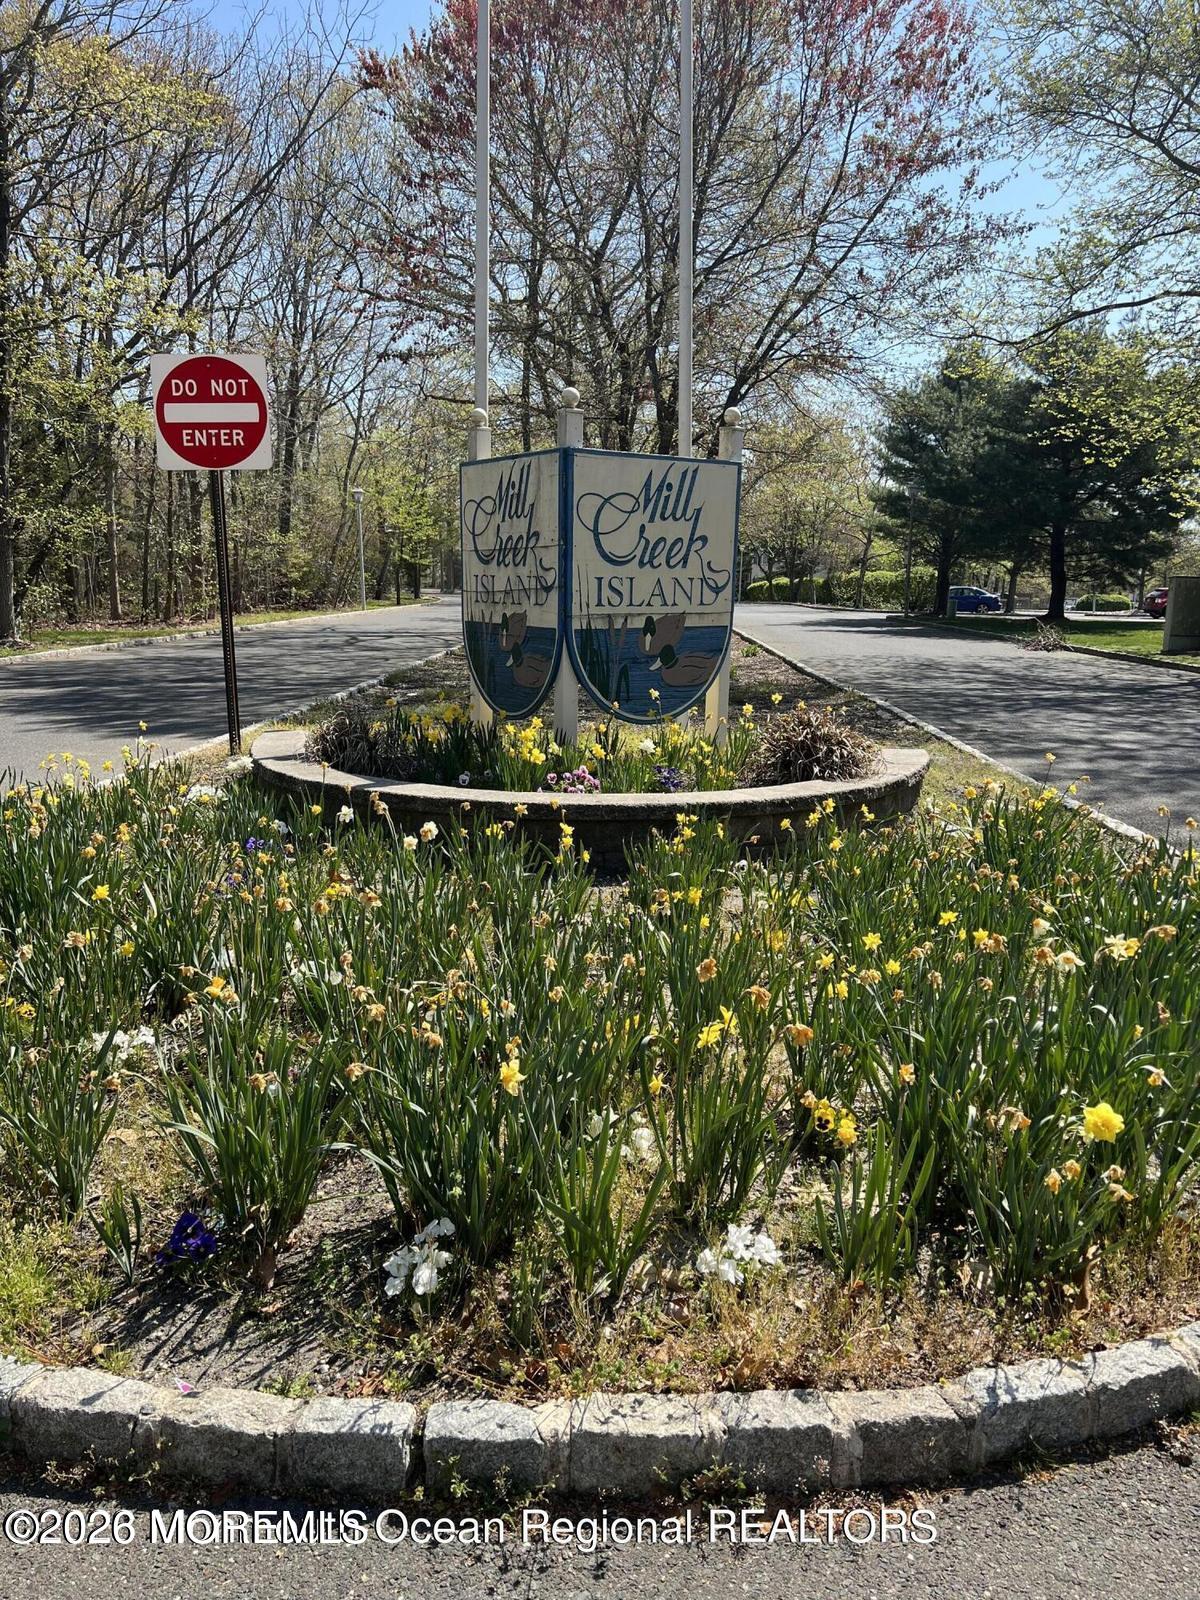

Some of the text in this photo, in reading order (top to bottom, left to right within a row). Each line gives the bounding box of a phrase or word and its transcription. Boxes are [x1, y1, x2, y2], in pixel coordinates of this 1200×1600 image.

[171, 379, 249, 396] DO NOT
[182, 429, 245, 447] ENTER
[494, 460, 532, 523] Mill
[639, 462, 702, 523] Mill
[463, 495, 557, 593] Creek
[576, 492, 731, 594] Creek
[473, 574, 550, 607] ISLAND
[594, 576, 720, 608] ISLAND
